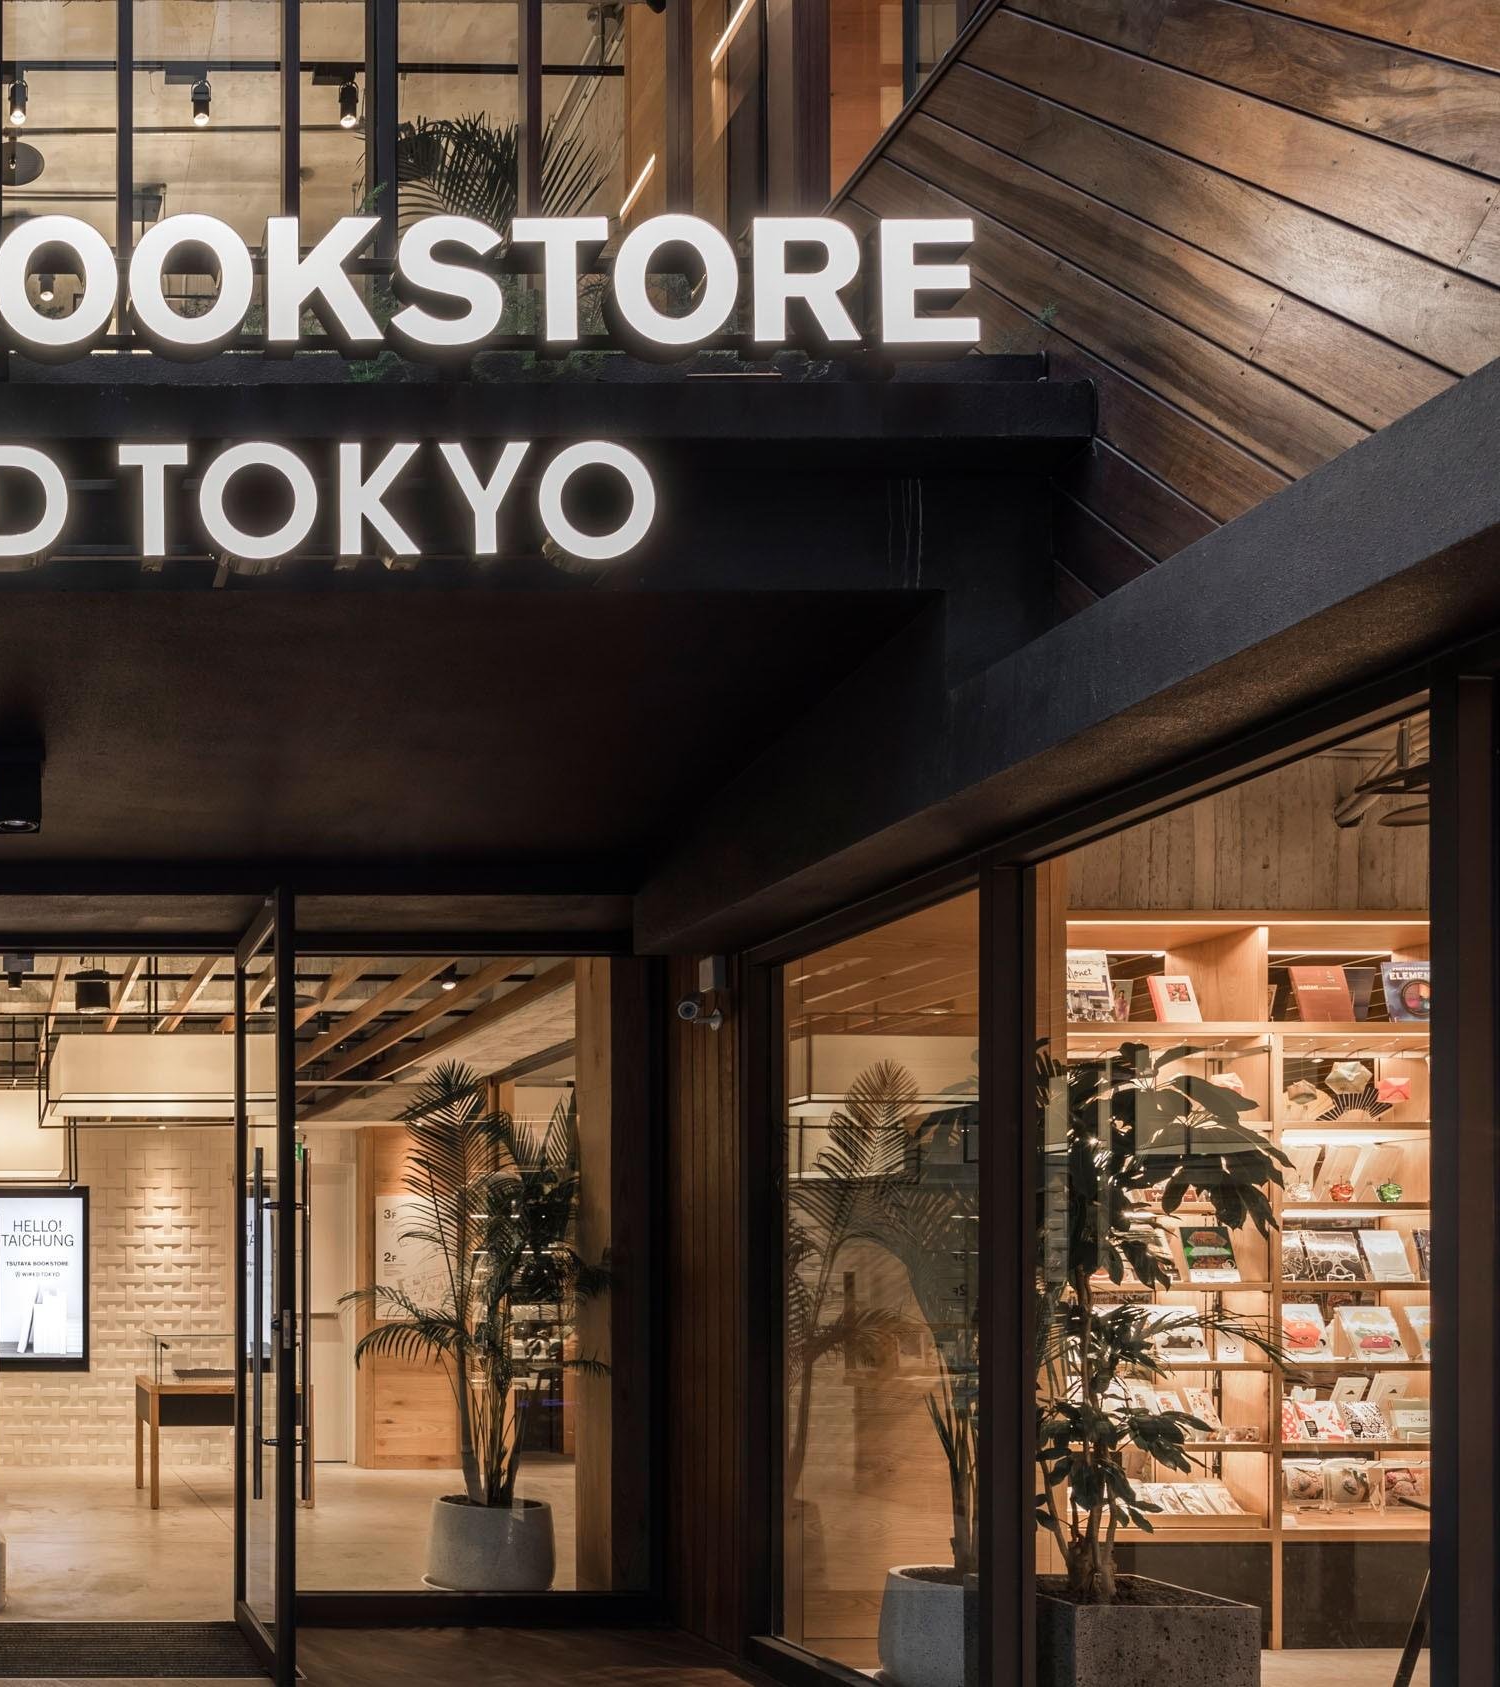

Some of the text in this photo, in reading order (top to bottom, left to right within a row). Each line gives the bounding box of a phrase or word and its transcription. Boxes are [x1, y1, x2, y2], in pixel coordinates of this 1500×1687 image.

[118, 440, 656, 560] TOKYO
[383, 1209, 397, 1220] 3F
[13, 1219, 62, 1232] HELLO!
[1, 1234, 74, 1247] TAICHUNG
[383, 1252, 397, 1262] 2F
